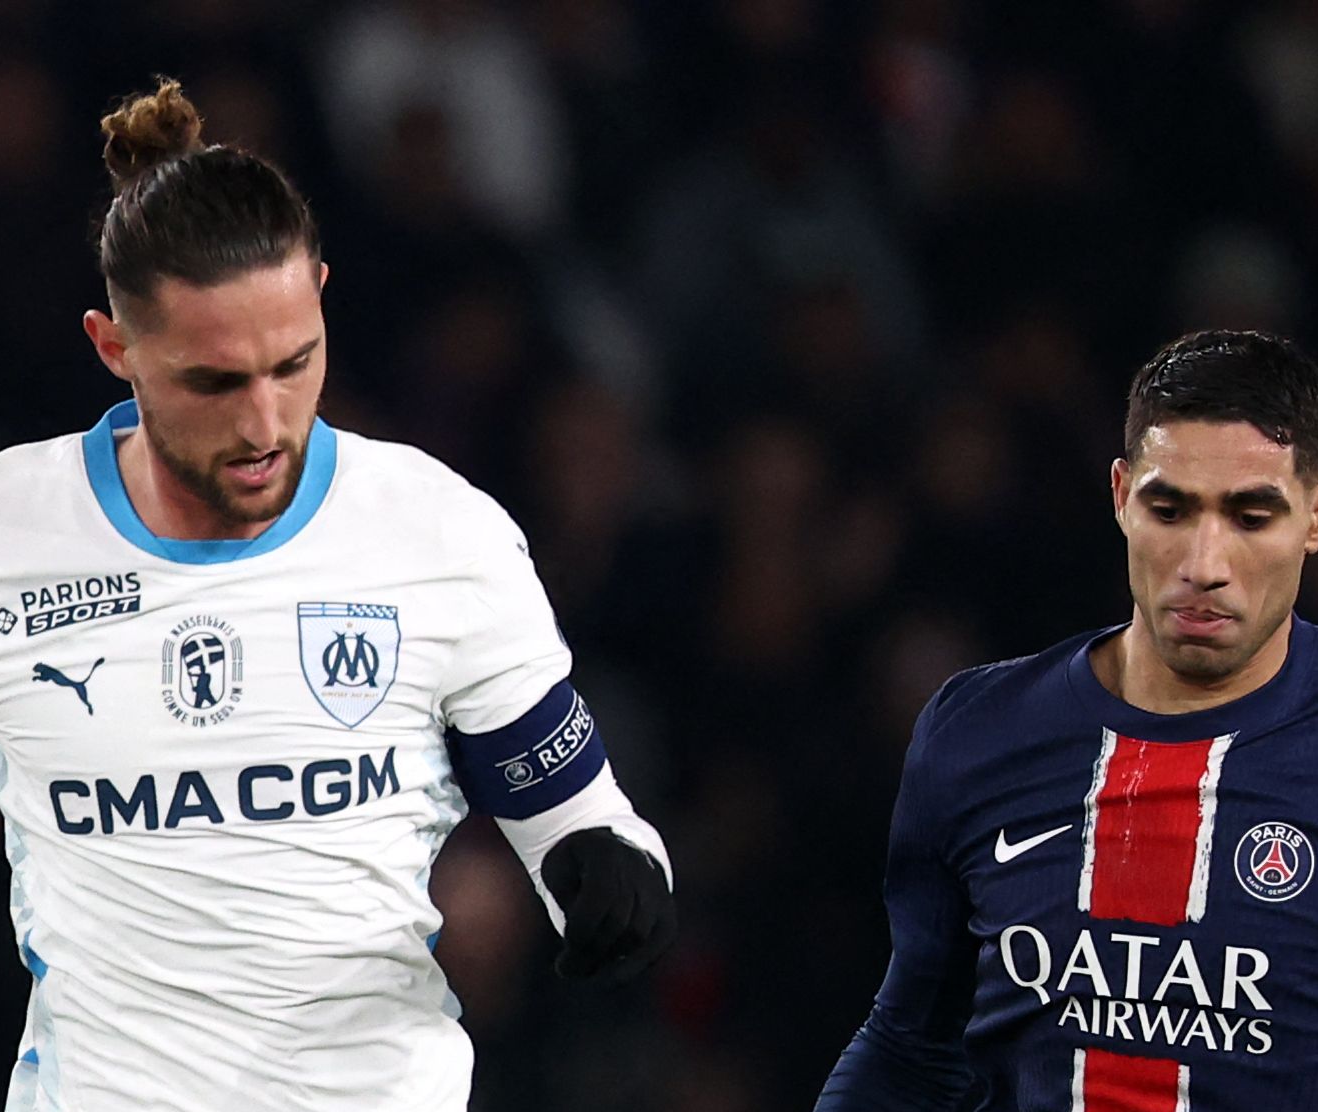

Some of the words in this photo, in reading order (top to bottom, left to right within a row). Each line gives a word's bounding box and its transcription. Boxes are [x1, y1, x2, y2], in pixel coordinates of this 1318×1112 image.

[21, 572, 141, 612] PARIONS
[30, 597, 138, 634] SPORT
[538, 695, 590, 769] RESPEC
[49, 770, 224, 835] CMA
[238, 746, 401, 821] CGM
[1250, 826, 1303, 848] PARIS
[1000, 925, 1273, 1011] QATAR
[1058, 996, 1273, 1054] AIRWAYS
